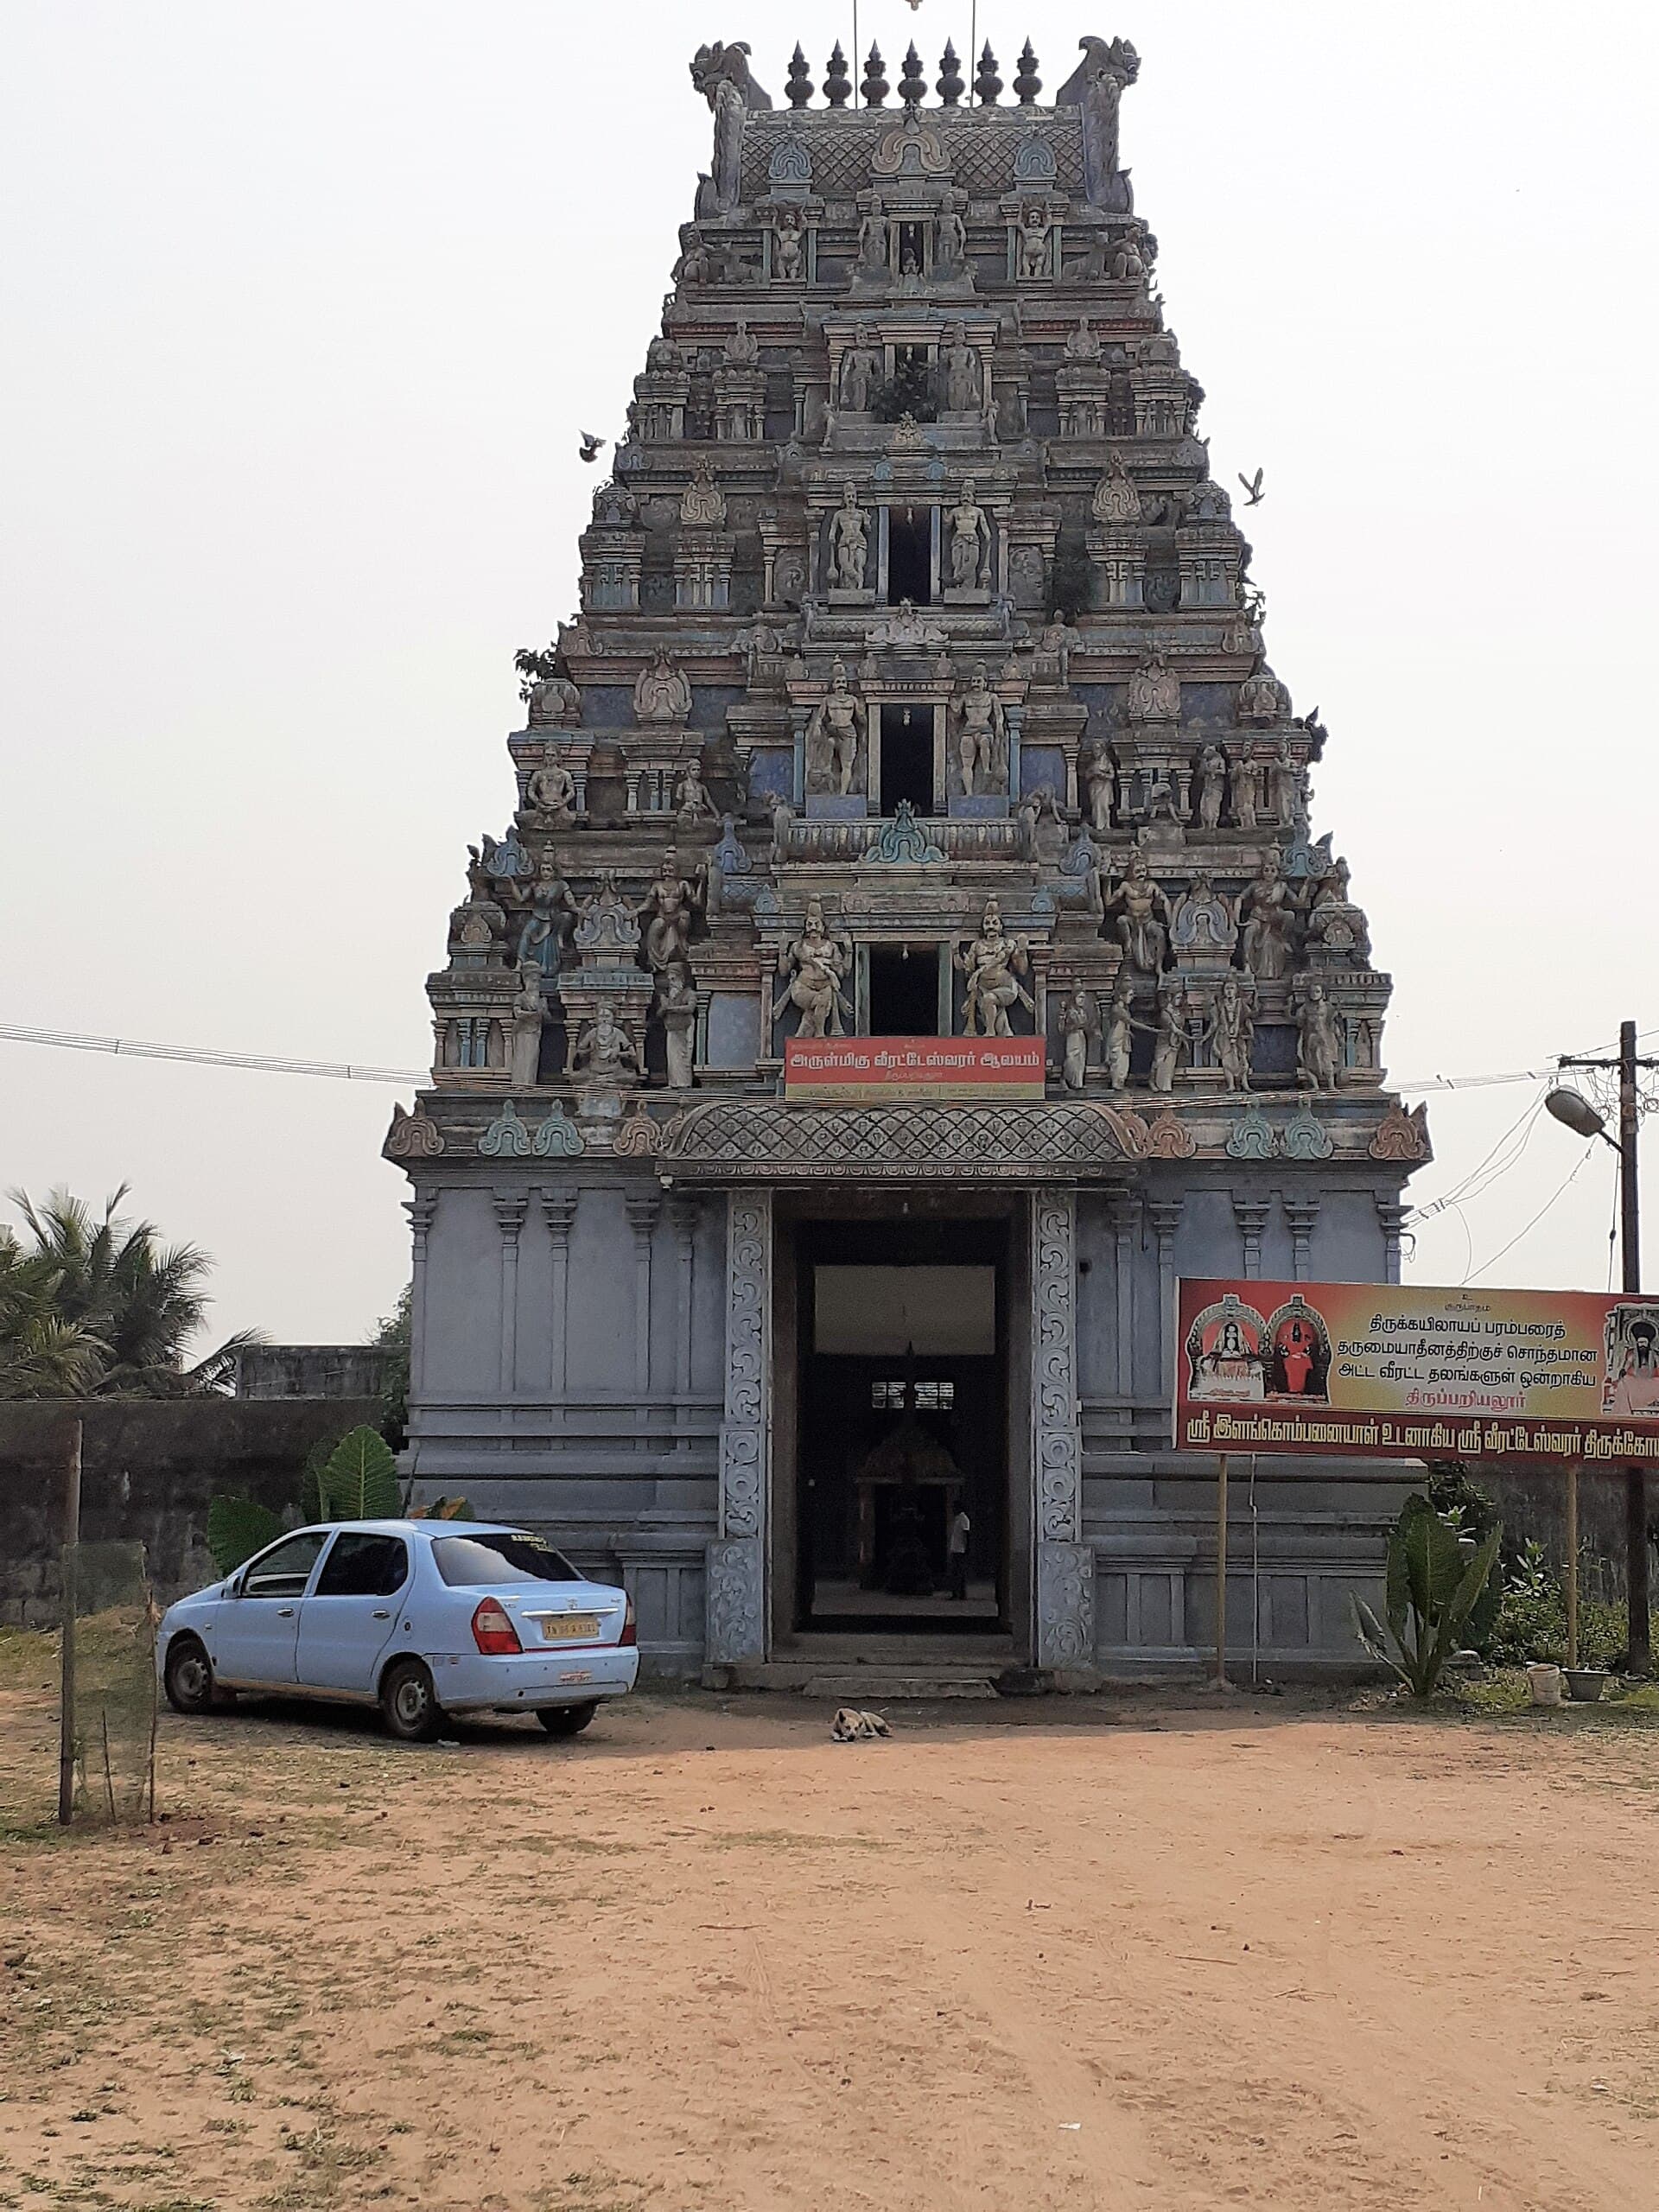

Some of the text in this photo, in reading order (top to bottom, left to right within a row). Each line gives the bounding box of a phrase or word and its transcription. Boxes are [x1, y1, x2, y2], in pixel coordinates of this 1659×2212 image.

[791, 1051, 1039, 1070] அருள்மிகு வீரட்டேஸ்வரர் ஆலயம்
[1369, 1313, 1566, 1341] திருக்கயிலாயப் பரம்பரைத்
[1337, 1338, 1598, 1365] தருமையாதீனத்திற்குச் சொந்தமான
[1338, 1361, 1596, 1389] அட்ட வீரட்ட தலங்களுள் ஒன்றாகிய
[1405, 1388, 1526, 1412] திருப்பறியலூர்
[1382, 1422, 1455, 1448] உடனாகிய
[1484, 1421, 1582, 1457] வீரட்டேஸ்வரர்
[1583, 1428, 1659, 1460] திருக்கோ
